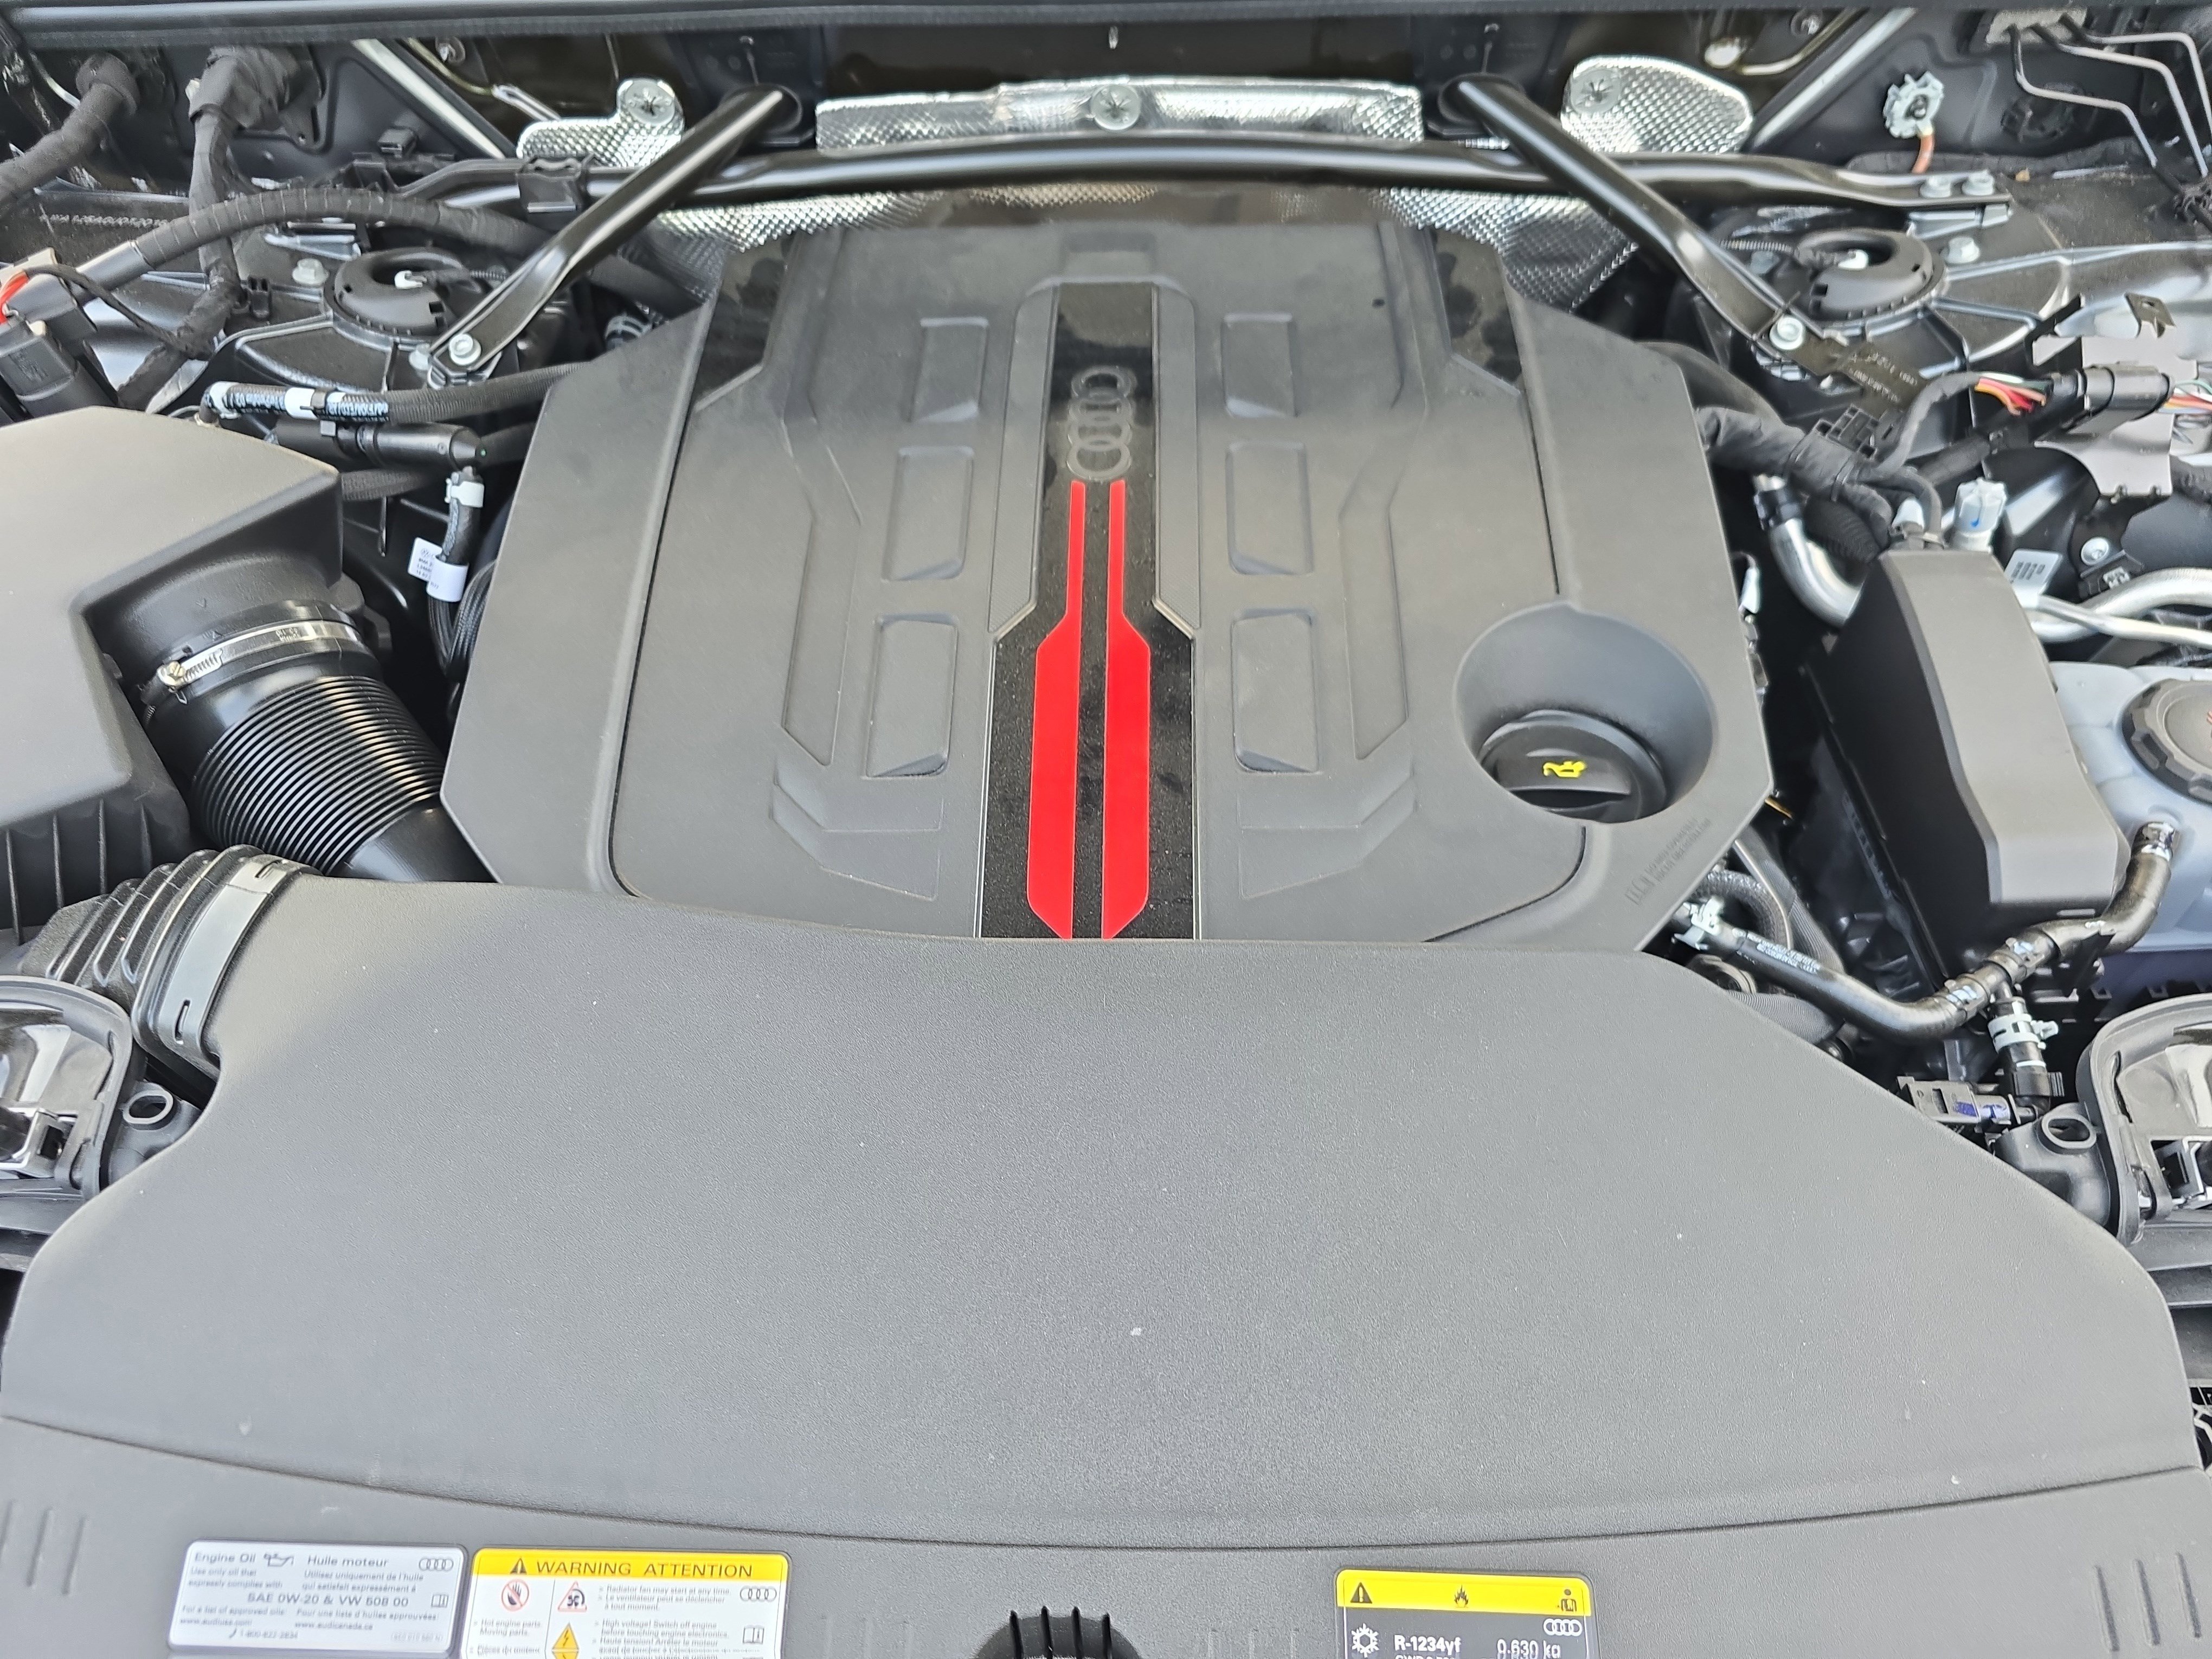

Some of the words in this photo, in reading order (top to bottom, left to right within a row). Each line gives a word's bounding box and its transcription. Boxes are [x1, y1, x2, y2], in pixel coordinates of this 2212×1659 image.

[195, 1552, 235, 1564] Engine
[240, 1553, 256, 1563] Oil
[307, 1554, 338, 1566] Huile
[342, 1557, 389, 1567] moteur
[536, 1561, 631, 1576] WARNING
[644, 1562, 753, 1577] ATTENTION
[304, 1570, 333, 1579] Utilisez
[336, 1571, 384, 1581] uniquement
[387, 1572, 396, 1580] de
[302, 1582, 316, 1591] qui
[318, 1583, 349, 1591] satisfait
[351, 1584, 409, 1593] expressément
[607, 1584, 637, 1593] Radiator
[653, 1586, 668, 1595] may
[247, 1592, 274, 1603] SAE
[324, 1595, 333, 1605] &
[339, 1595, 362, 1606] VW
[366, 1596, 389, 1606] 508
[393, 1596, 409, 1607] 00
[657, 1596, 673, 1604] peut
[496, 1619, 520, 1628] engine
[602, 1618, 619, 1628] High
[654, 1620, 678, 1628] Switch
[692, 1622, 717, 1630] engine
[480, 1627, 507, 1636] Moving
[601, 1628, 625, 1636] before
[627, 1629, 659, 1637] touching
[661, 1630, 686, 1638] engine
[600, 1636, 622, 1644] Haute
[1394, 1635, 1462, 1656] R-1234yf
[1497, 1638, 1539, 1656] 0.630
